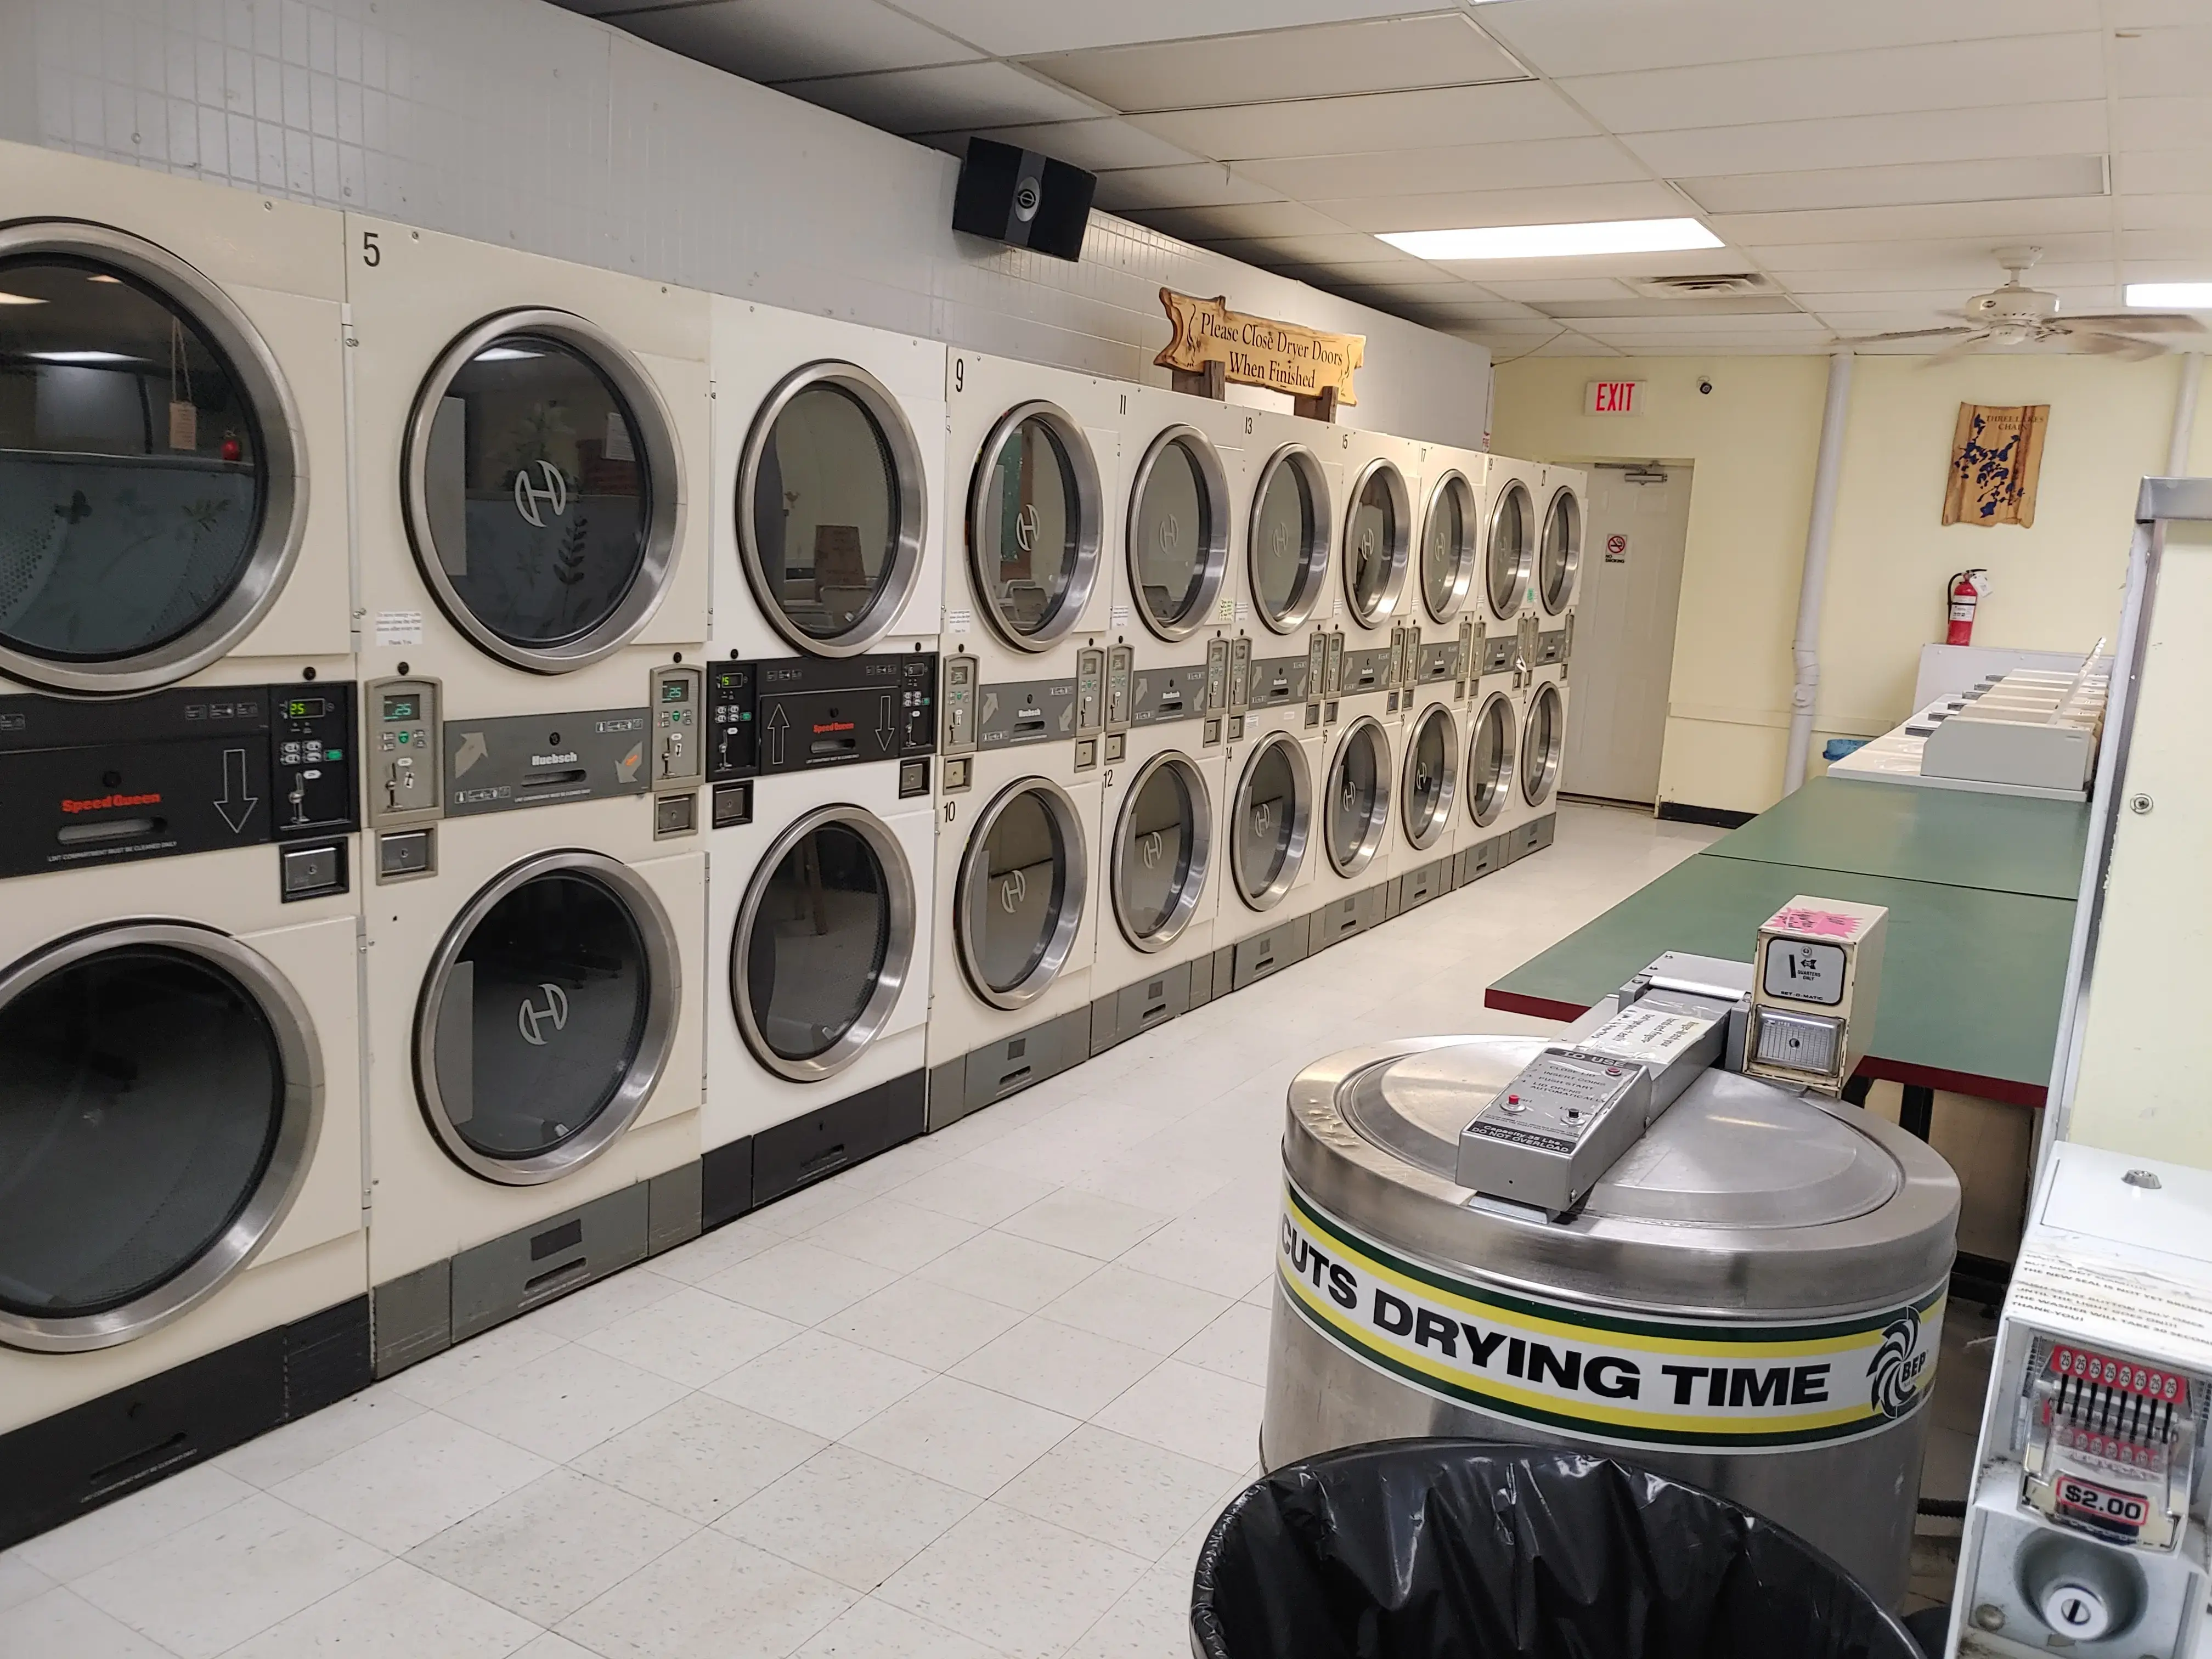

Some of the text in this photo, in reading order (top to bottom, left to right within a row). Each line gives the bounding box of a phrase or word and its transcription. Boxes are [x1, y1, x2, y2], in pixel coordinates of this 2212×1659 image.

[364, 232, 380, 267] 5
[1200, 312, 1343, 366] Please Close Dryer Doors
[956, 358, 963, 392] 9
[1229, 351, 1316, 389] When Finished
[1120, 394, 1126, 415] 11
[1595, 383, 1635, 411] EXIT
[1245, 416, 1252, 434] 13
[1342, 434, 1348, 449] 15
[1421, 448, 1426, 462] 17
[814, 723, 834, 733] Speed
[532, 752, 577, 766] Huebsch
[1226, 746, 1232, 761] 14
[1103, 769, 1113, 788] 12
[61, 794, 161, 814] Speed Queen
[944, 801, 955, 822] 10
[1549, 1065, 1577, 1074] CLOSE
[1562, 1051, 1627, 1068] TO USE
[1544, 1071, 1576, 1080] INSERT
[1566, 1082, 1593, 1090] START
[1530, 1085, 1606, 1103] AUTOMATICALLY
[1551, 1085, 1581, 1094] OPENS
[1483, 1125, 1527, 1138] Capacity
[1542, 1137, 1564, 1147] Lbs.
[1488, 1130, 1513, 1139] NOT
[1512, 1136, 1570, 1153] OVERLOAD
[2046, 1271, 2072, 1280] NEW
[2075, 1277, 2101, 1286] SEAL
[2117, 1287, 2140, 1296] NOT
[2144, 1294, 2163, 1302] YET
[1279, 1212, 1831, 1407] CUTS DRYING TIME
[2012, 1301, 2084, 1322] THANK-YOU!
[2017, 1288, 2049, 1296] UNTIL
[2076, 1300, 2108, 1311] LIGHT
[2111, 1310, 2143, 1319] GOES
[2038, 1299, 2087, 1313] WASHER
[2090, 1311, 2117, 1321] WILL
[2121, 1319, 2149, 1329] TAKE
[2088, 1297, 2135, 1311] BUTTON
[2138, 1308, 2170, 1318] ONLY
[1902, 1351, 1926, 1383] BEP
[2061, 1353, 2175, 1393] 25 25 25 25 25 25 25 25
[2065, 1484, 2142, 1520] $2.00
